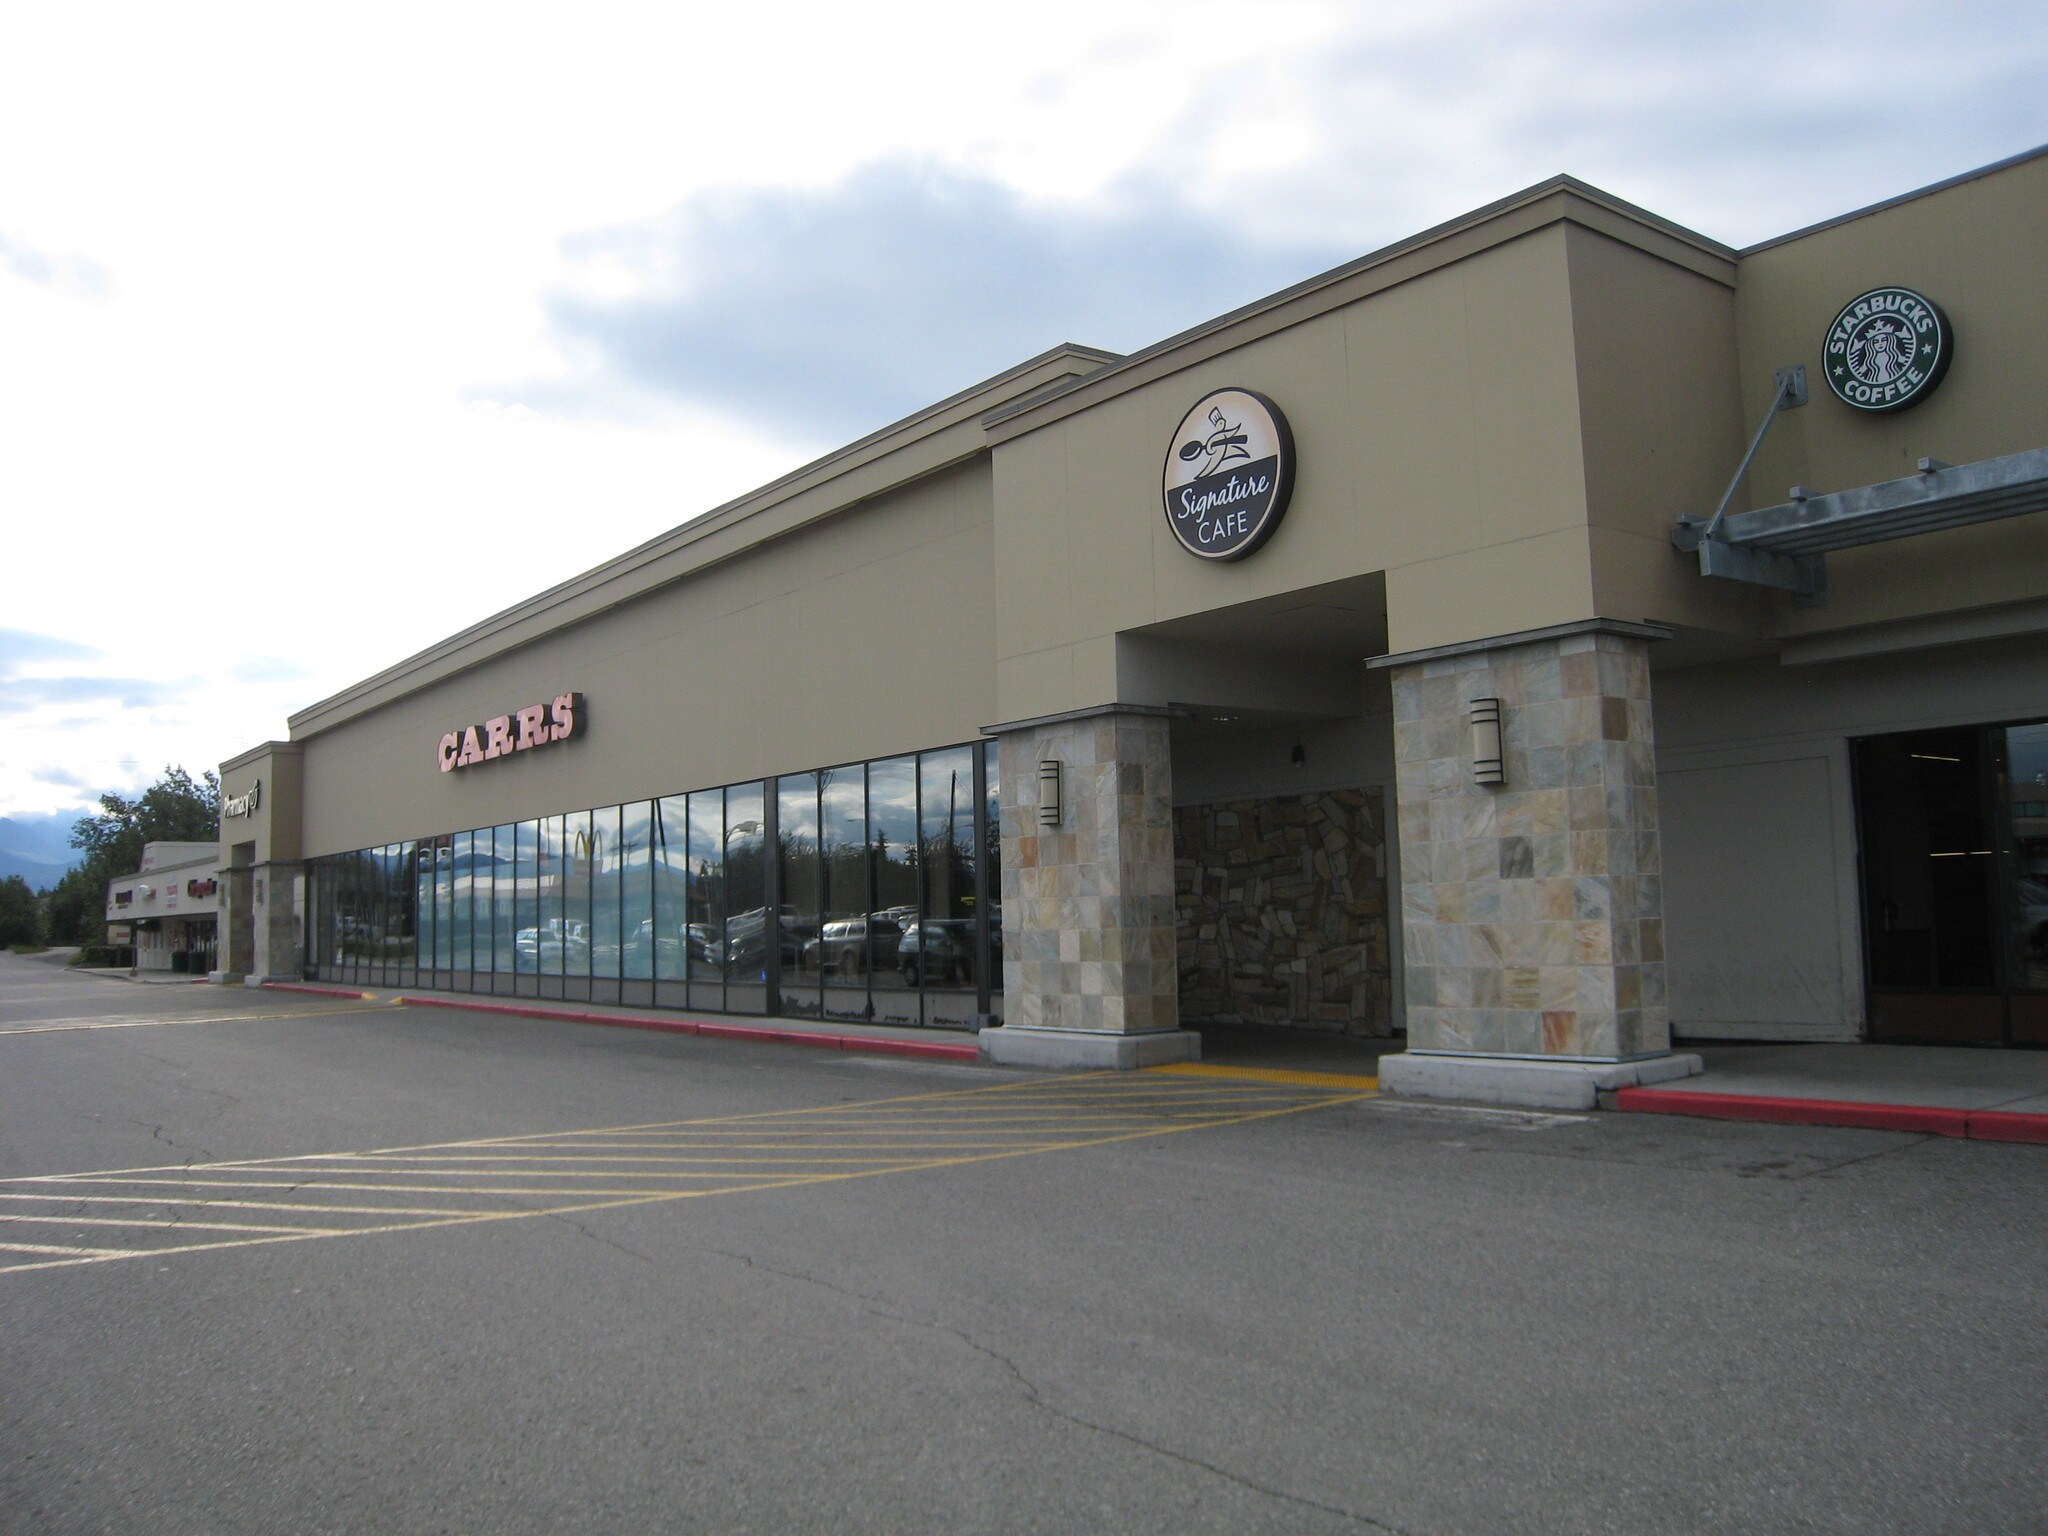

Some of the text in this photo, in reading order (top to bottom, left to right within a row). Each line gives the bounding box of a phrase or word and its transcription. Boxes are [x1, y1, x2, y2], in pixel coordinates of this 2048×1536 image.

[1829, 294, 1933, 354] STARBUCKS
[1843, 366, 1923, 403] COFFEE
[1177, 475, 1270, 523] Signature
[1197, 510, 1248, 544] CAFE
[436, 692, 576, 773] CARRS
[223, 790, 249, 819] Pharmacy
